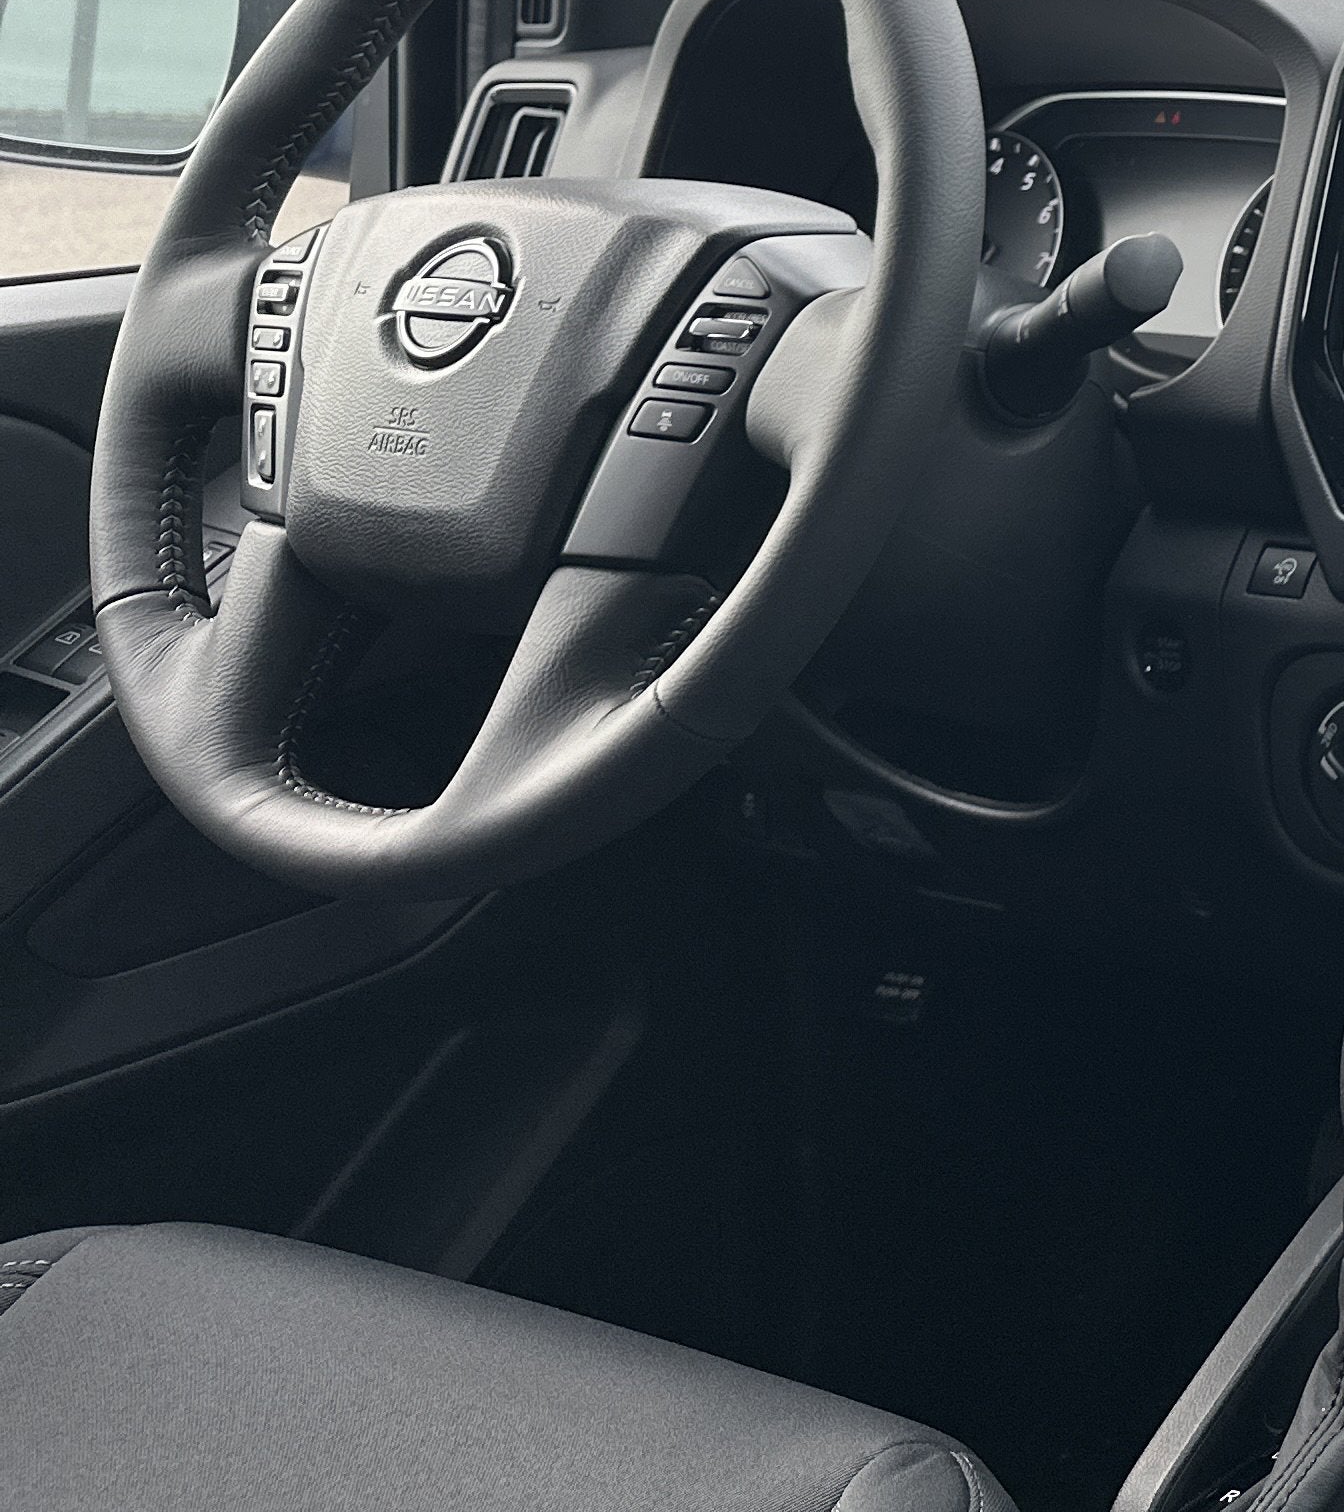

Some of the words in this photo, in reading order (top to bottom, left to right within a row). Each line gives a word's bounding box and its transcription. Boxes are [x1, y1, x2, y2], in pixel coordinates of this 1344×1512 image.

[1020, 172, 1036, 191] 5
[388, 405, 419, 426] SRS
[367, 432, 428, 456] AIRBAG
